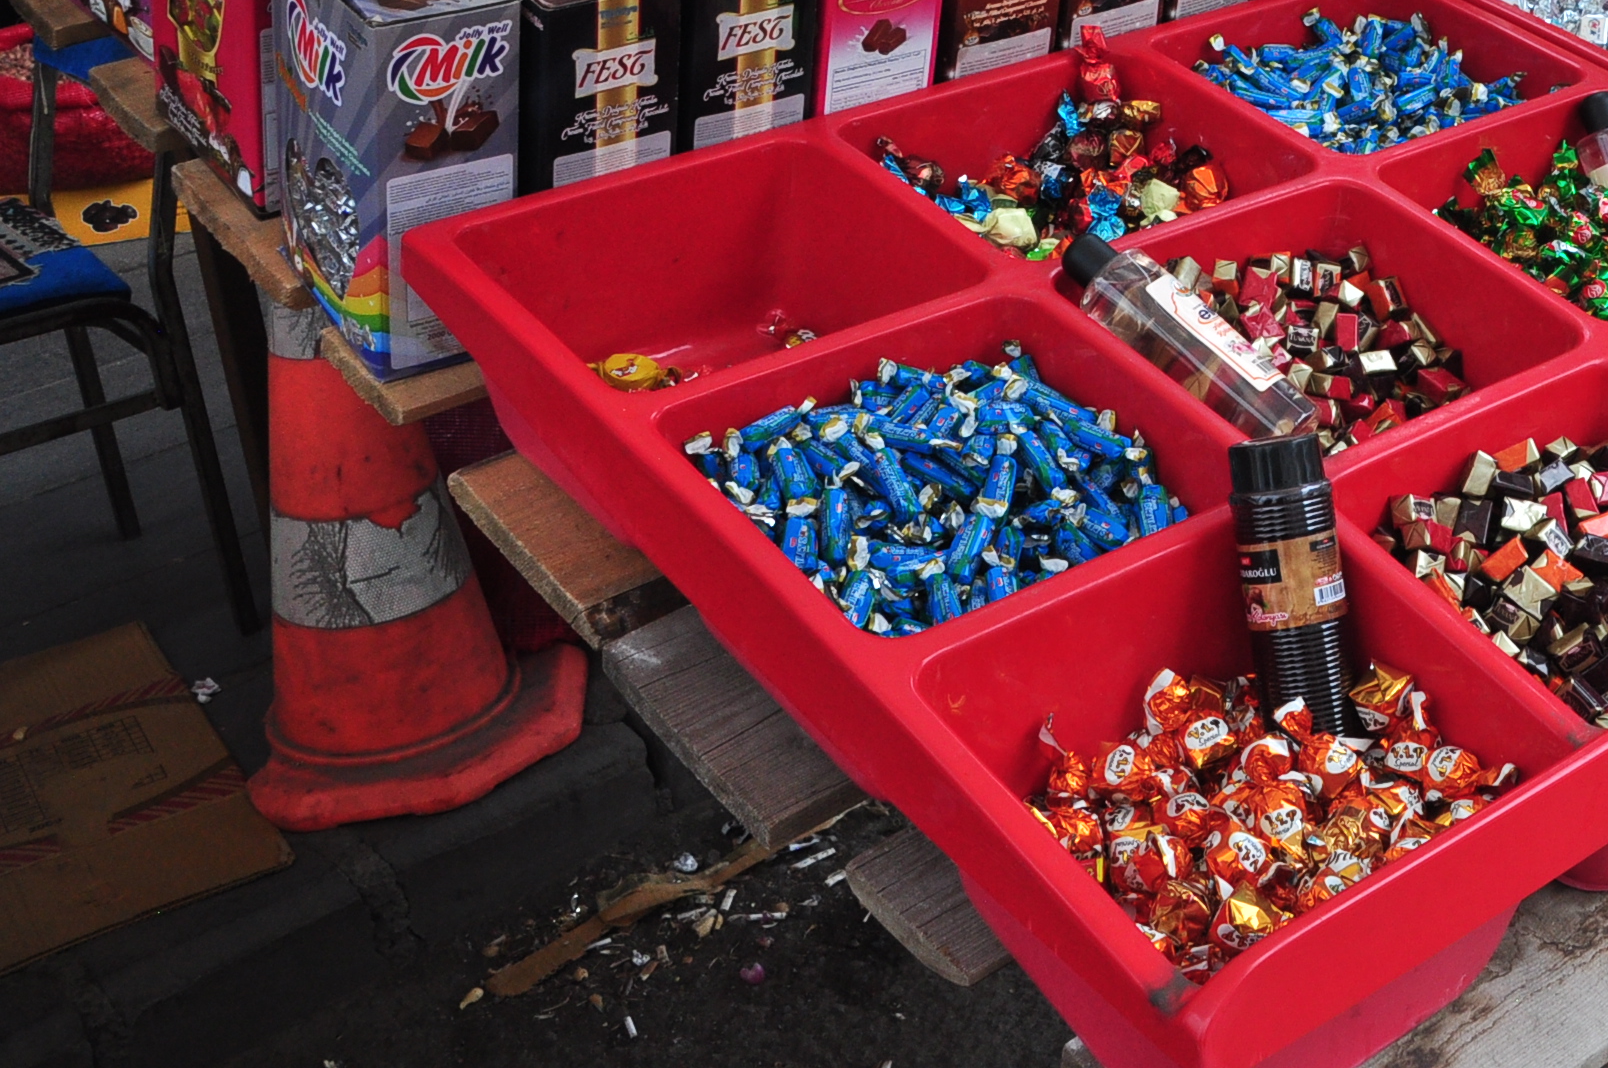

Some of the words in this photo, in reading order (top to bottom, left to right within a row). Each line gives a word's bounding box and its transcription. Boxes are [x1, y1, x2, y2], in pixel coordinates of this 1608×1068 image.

[458, 27, 484, 42] Jolly
[487, 23, 509, 37] Well
[720, 13, 792, 51] FEST
[297, 16, 343, 102] Milk
[413, 35, 506, 88] Milk
[578, 48, 654, 89] FEST
[1288, 332, 1316, 348] TUVANA
[1197, 728, 1228, 748] Special
[1391, 757, 1421, 769] Special
